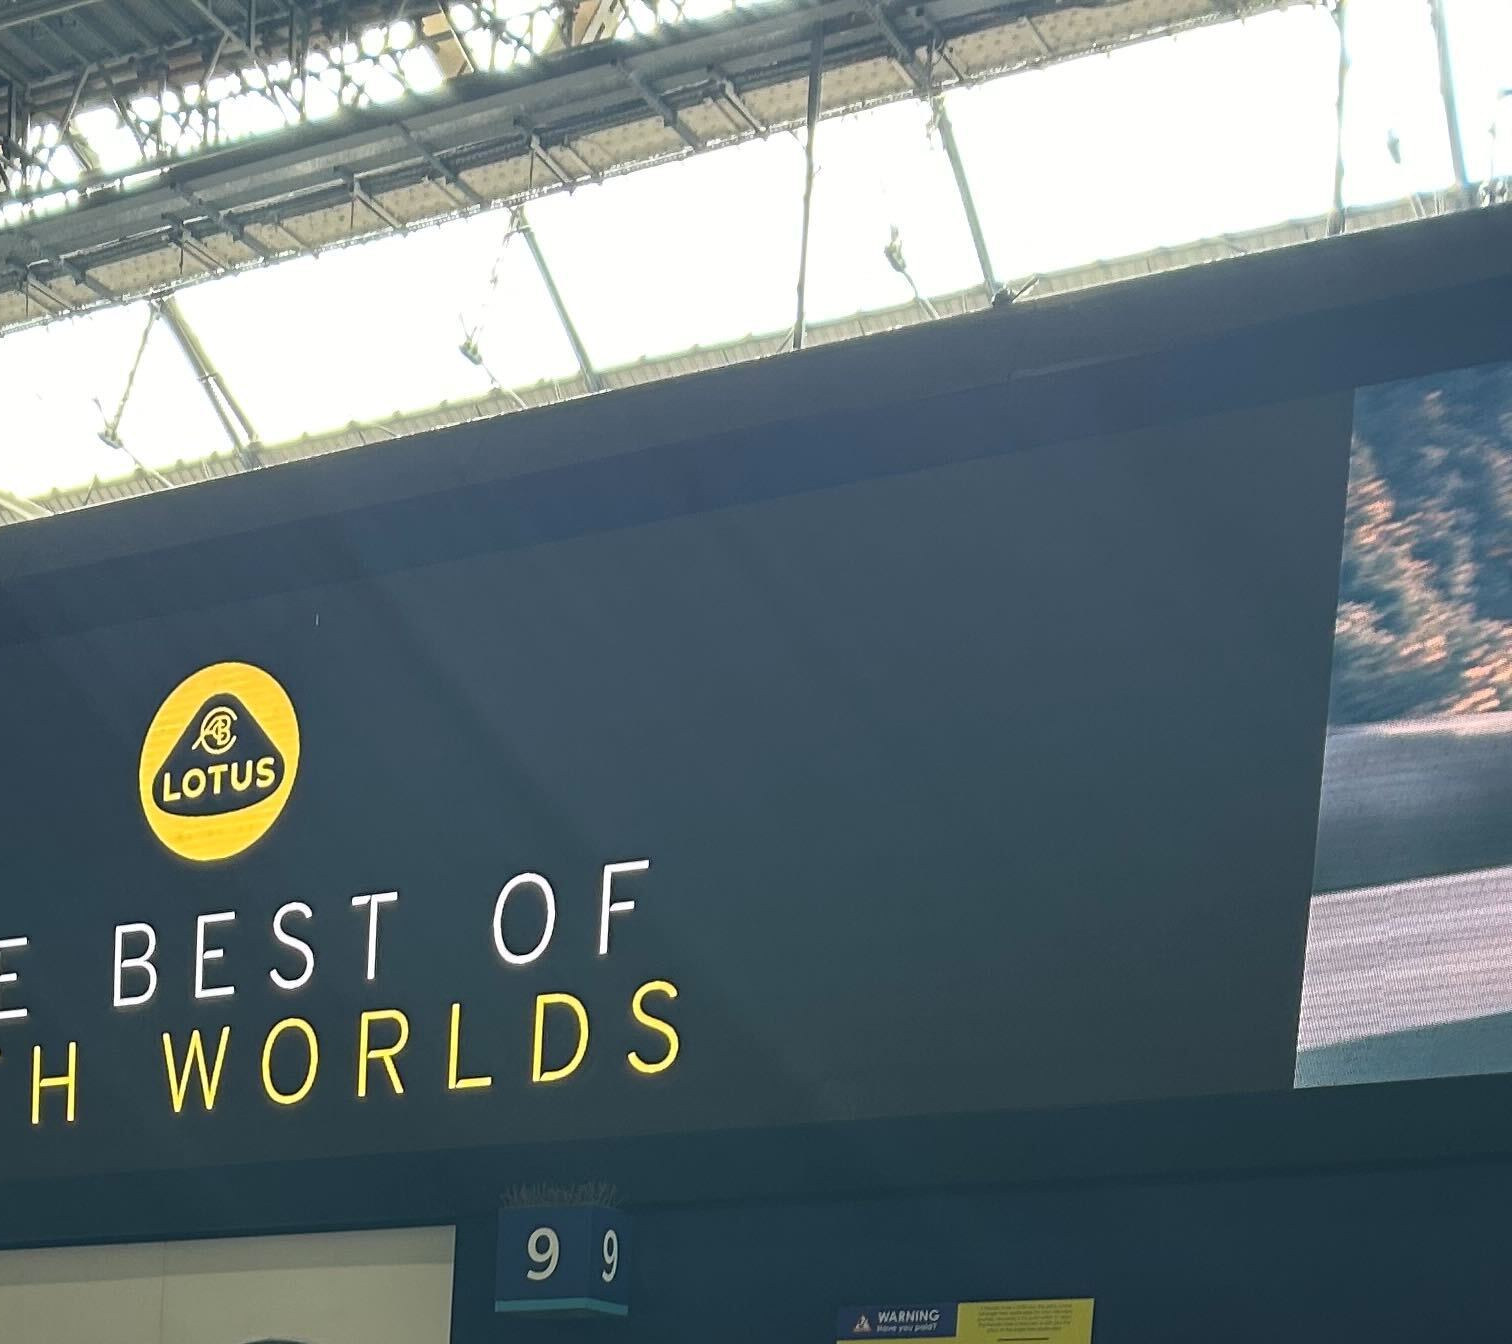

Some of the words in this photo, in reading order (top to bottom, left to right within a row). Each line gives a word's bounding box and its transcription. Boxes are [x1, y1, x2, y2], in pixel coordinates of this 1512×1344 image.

[161, 755, 277, 803] LOTUS
[113, 891, 399, 1007] BEST
[492, 859, 651, 965] OF
[163, 979, 681, 1113] WORLDS
[526, 1226, 560, 1280] 9
[601, 1229, 619, 1283] 9
[878, 1309, 941, 1323] WARNING
